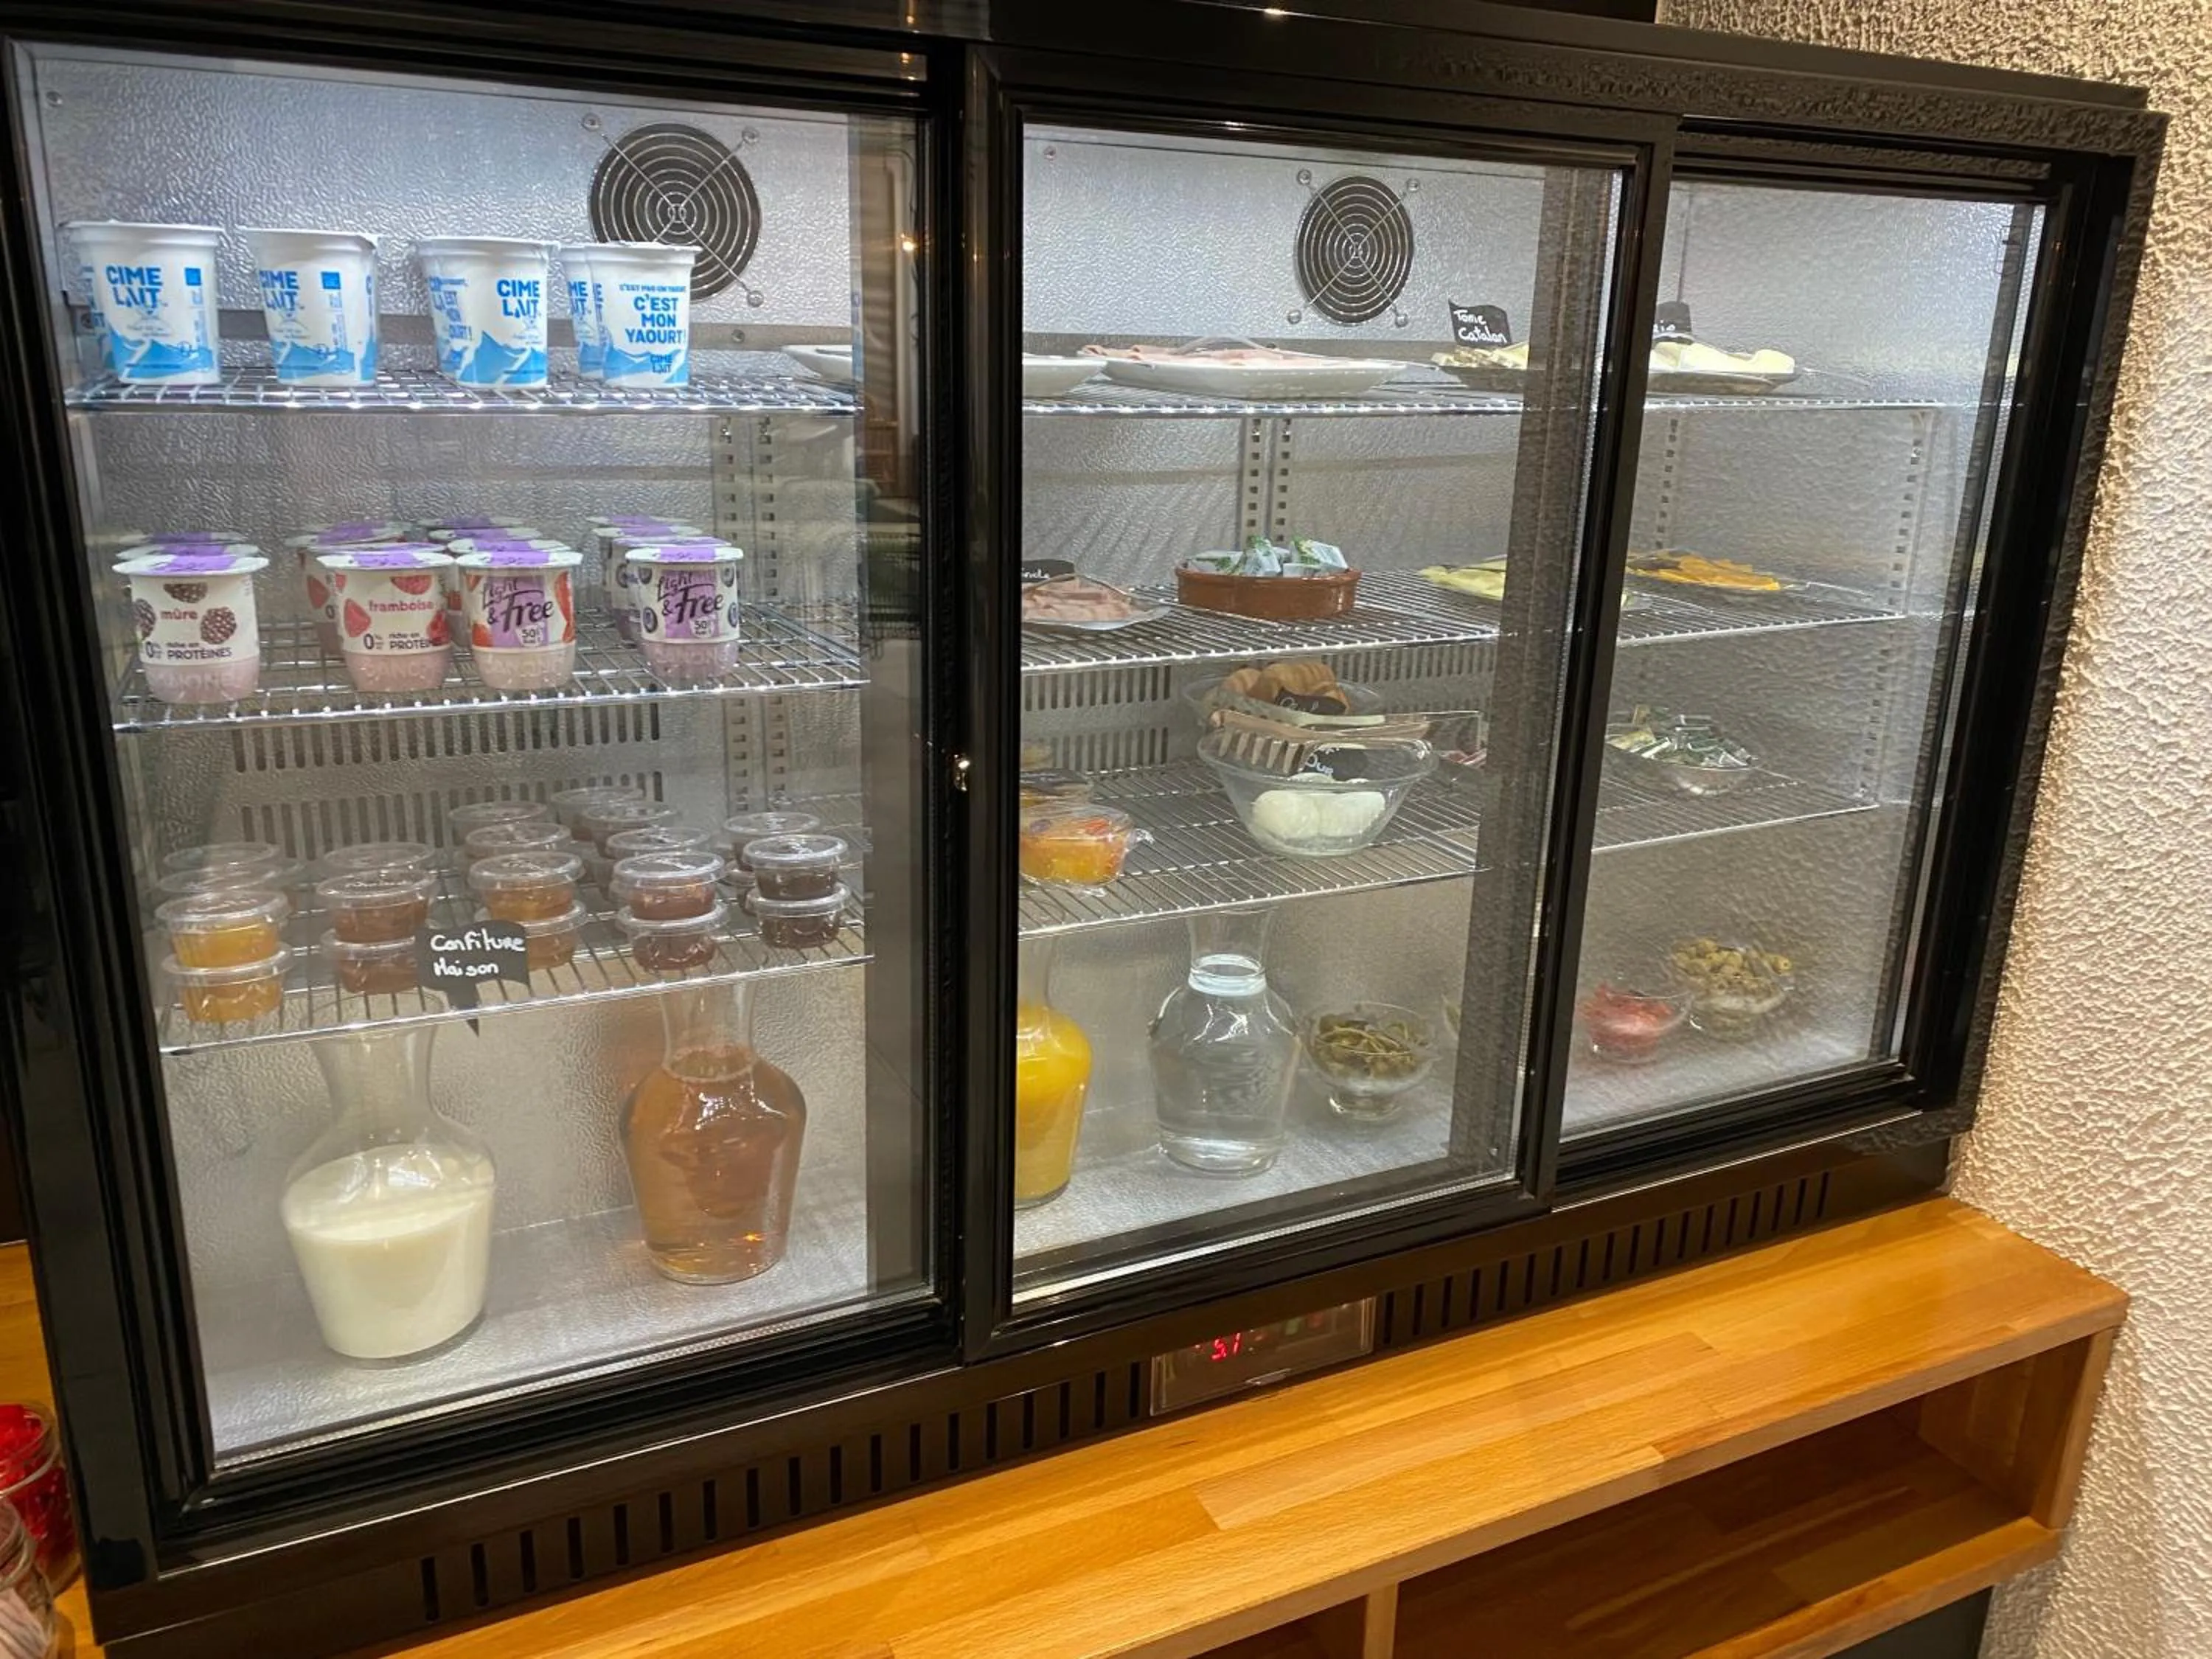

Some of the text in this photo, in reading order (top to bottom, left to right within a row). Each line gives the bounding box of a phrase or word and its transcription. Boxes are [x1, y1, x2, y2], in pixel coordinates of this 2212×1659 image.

[106, 265, 163, 286] CIME
[112, 287, 161, 308] LAIT
[497, 279, 540, 298] CIME
[502, 299, 540, 319] LAIT
[634, 293, 679, 312] C'EST
[641, 313, 676, 328] MON
[1458, 325, 1508, 344] Catalan
[369, 599, 434, 611] framboise
[487, 589, 554, 633] & Free
[661, 583, 724, 625] & Free
[161, 608, 198, 620] mûre
[167, 647, 232, 660] PROTÉINES
[430, 928, 526, 952] Confiture
[433, 956, 499, 977] Maison
